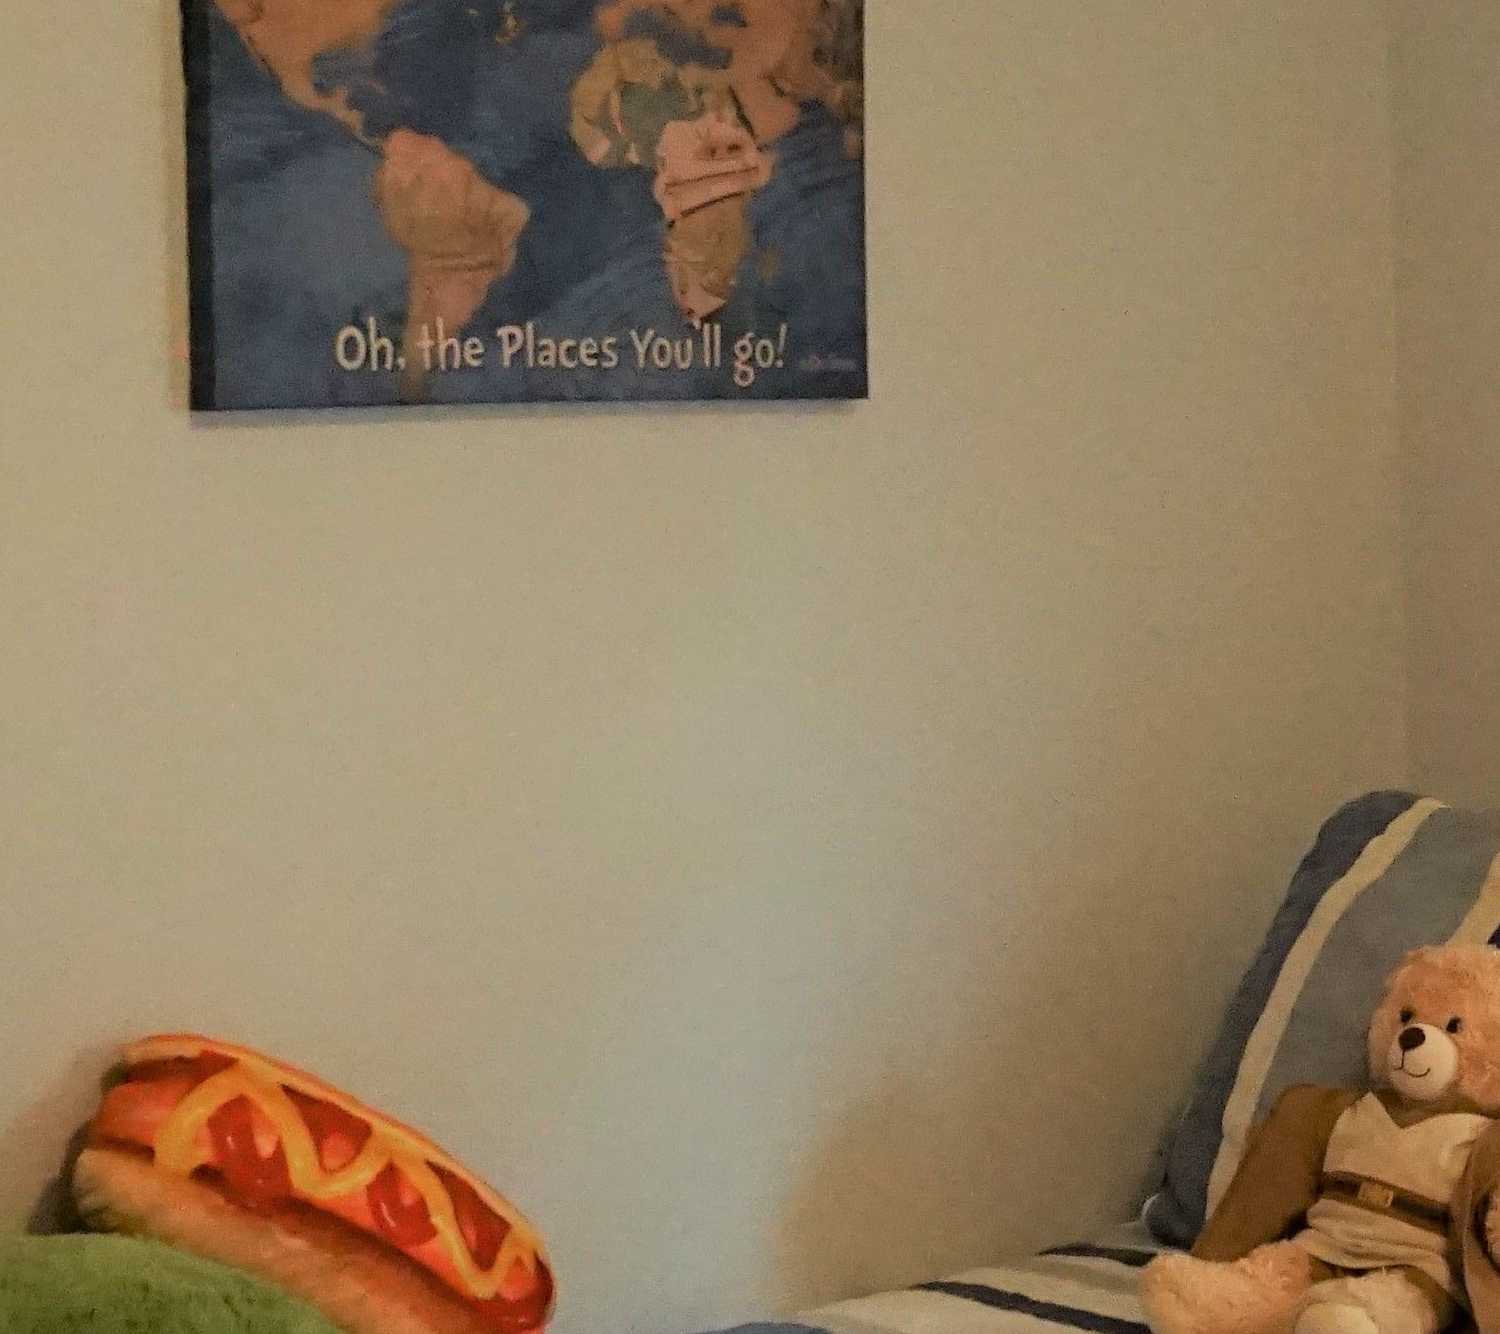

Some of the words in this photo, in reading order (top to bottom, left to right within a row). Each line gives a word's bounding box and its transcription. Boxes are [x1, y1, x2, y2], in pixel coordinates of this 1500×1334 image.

[335, 316, 406, 371] Oh,
[417, 318, 487, 369] the
[497, 321, 619, 369] Places
[630, 321, 722, 369] You'll
[733, 323, 788, 388] go!
